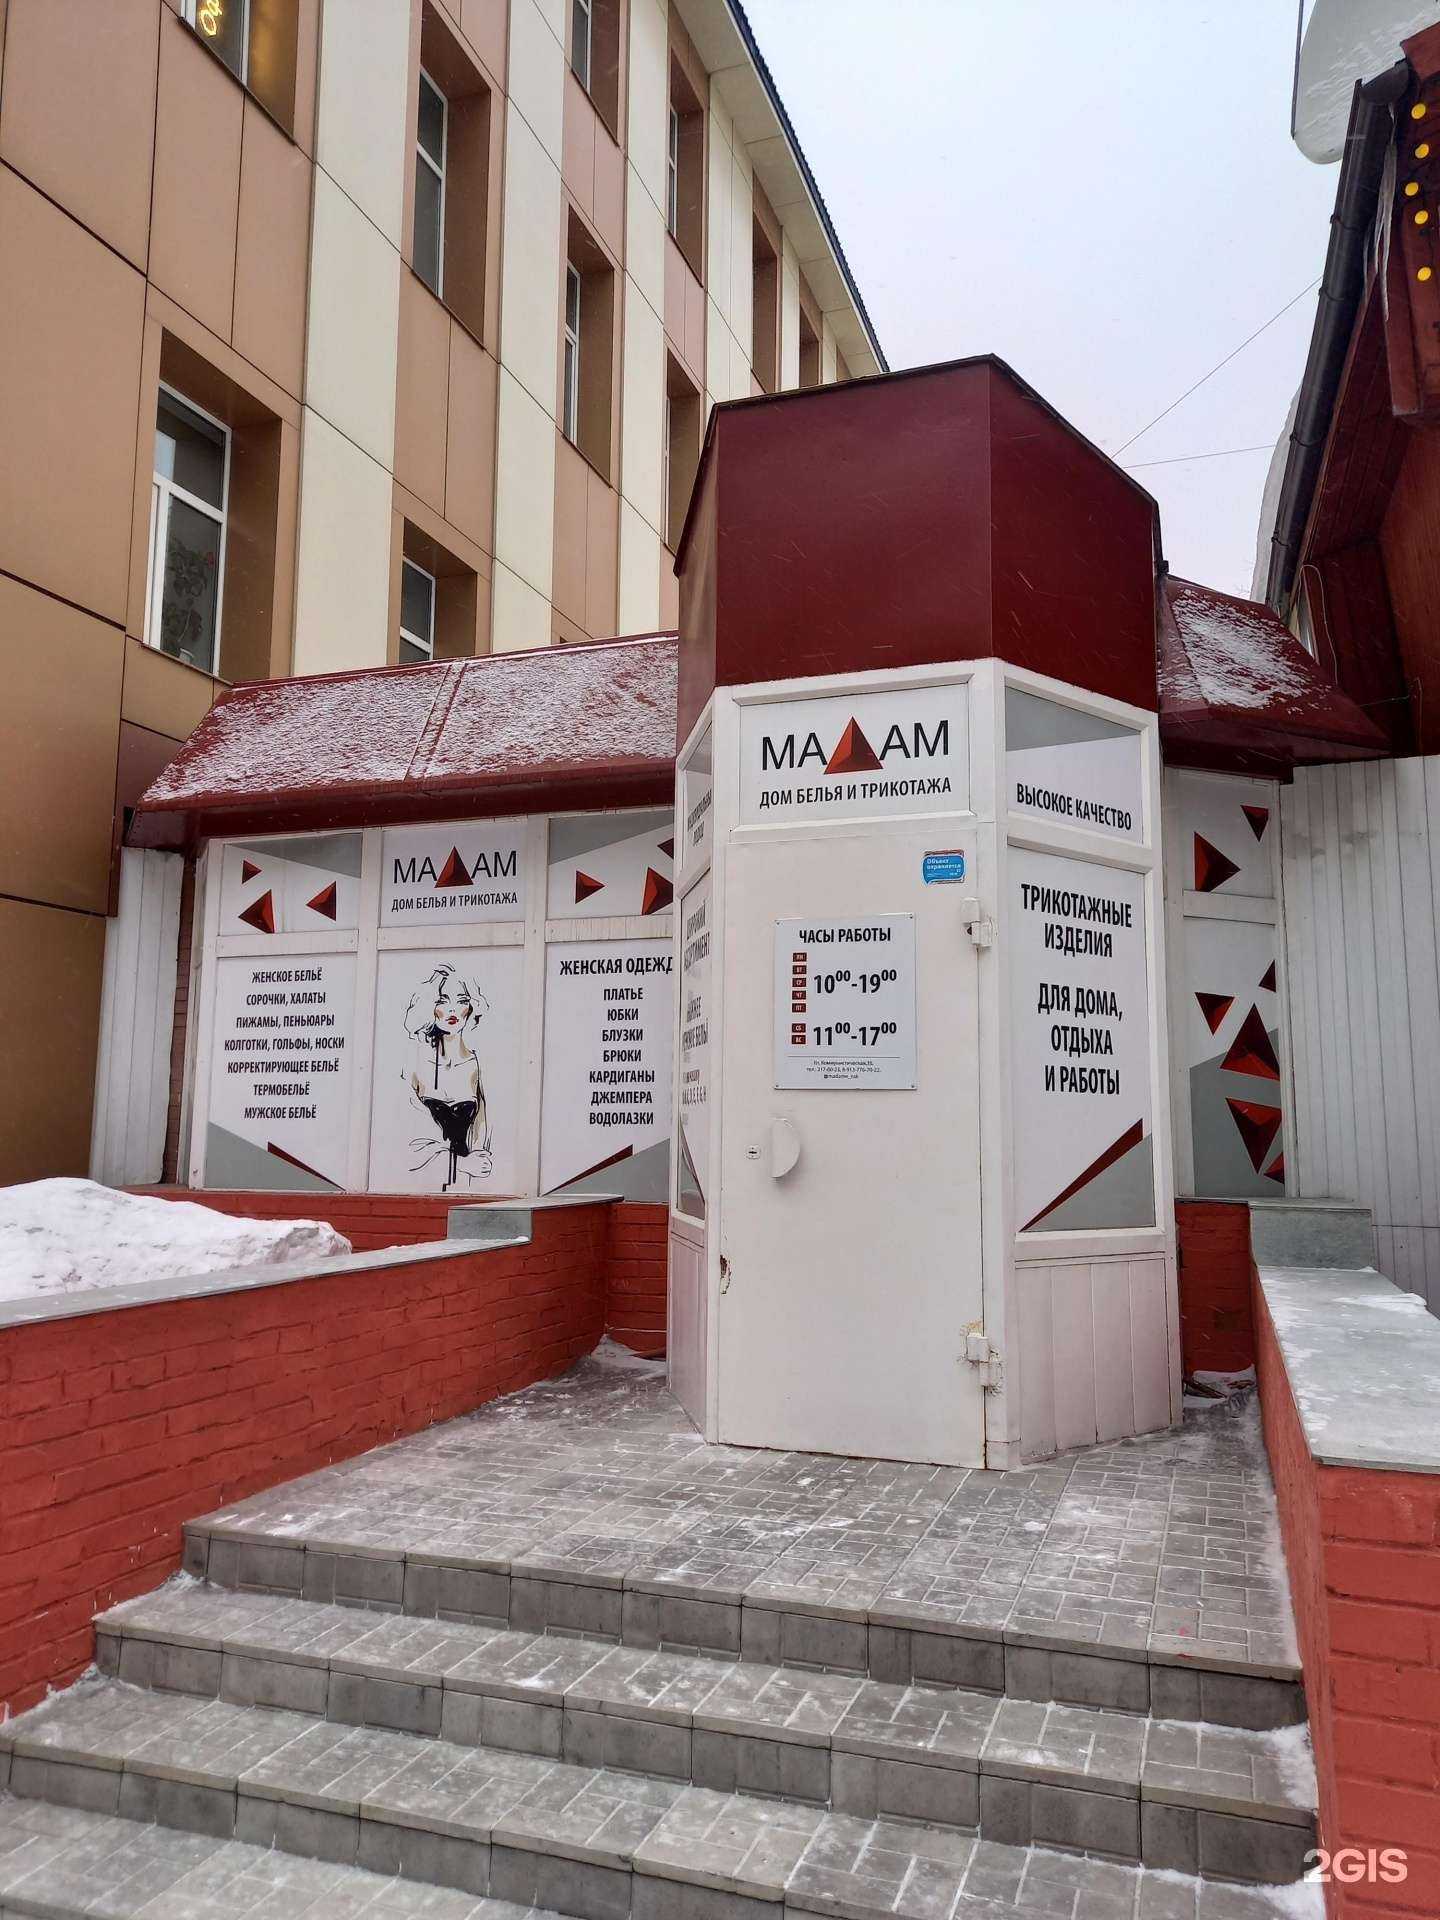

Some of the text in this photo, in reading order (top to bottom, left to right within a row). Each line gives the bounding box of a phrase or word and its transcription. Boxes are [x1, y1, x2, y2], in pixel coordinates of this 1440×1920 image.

[759, 776, 952, 809] ДОМ БЕЛЬЯ И ТРИКОТАЖА
[1016, 783, 1132, 831] ВЫСОКОЕ КАЧЕСТВО
[391, 892, 519, 913] ДОМ БЕЛЬЯ И ТРИКОТАЖА
[1021, 883, 1133, 928] ТРИКОТАЖНЫЕ
[799, 927, 891, 943] ЧАСЫ РАБОТЫ
[1044, 922, 1113, 958] ИЗДЕЛИЯ
[252, 967, 322, 983] ЖЕНСКОЕ БЕЛЬЁ
[560, 959, 622, 976] ЖЕНСКАЯ
[246, 992, 326, 1007] СОРОЧКИ, ХАЛАТЫ
[603, 988, 643, 1001] ПЛАТЬЕ
[1038, 983, 1123, 1021] ДЛЯ ДОМА,
[236, 1014, 335, 1029] ПИЖАМЫ, ПЕНЬЮАРЫ
[607, 1008, 639, 1021] ЮБКИ
[602, 1029, 643, 1042] БЛУЗКИ
[1051, 1025, 1113, 1057] ОТДЫХА
[224, 1037, 345, 1051] КОЛГОТКИ, ГОЛЬФЫ, НОСКИ
[603, 1050, 641, 1062] БРЮКИ
[227, 1058, 339, 1074] КОРРЕКТИРУЮЩЕЕ БЕЛЬЁ
[589, 1071, 655, 1085] КАРДИГАНЫ
[1045, 1066, 1120, 1095] И РАБОТЫ
[253, 1082, 310, 1096] ТЕРМОБЕЛЬЁ
[591, 1091, 653, 1106] ДЖЕМПЕРА
[244, 1105, 317, 1119] МУЖСКОЕ БЕЛЬЁ
[589, 1112, 654, 1127] ВОДОЛАЗКИ
